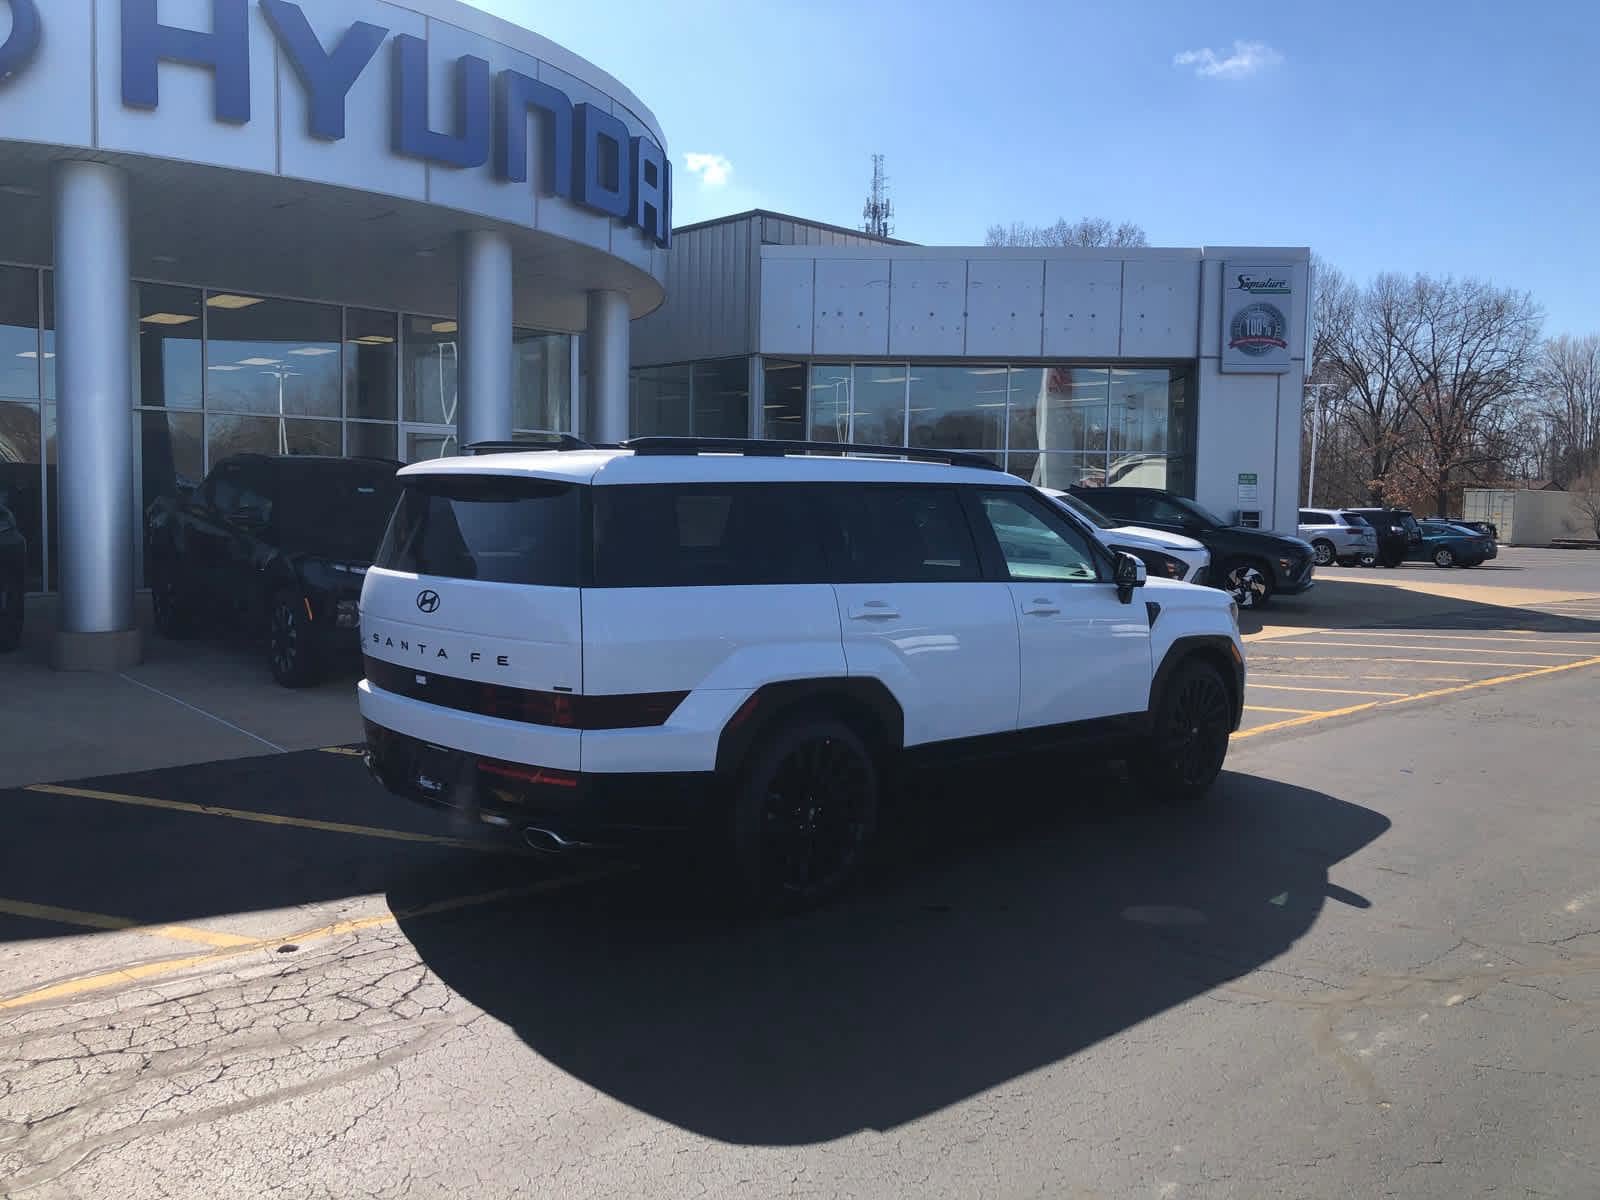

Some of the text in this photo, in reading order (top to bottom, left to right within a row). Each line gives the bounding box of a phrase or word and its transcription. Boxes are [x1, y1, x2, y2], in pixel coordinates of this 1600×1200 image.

[1238, 274, 1286, 290] Signature
[373, 632, 510, 667] SANTA FE
